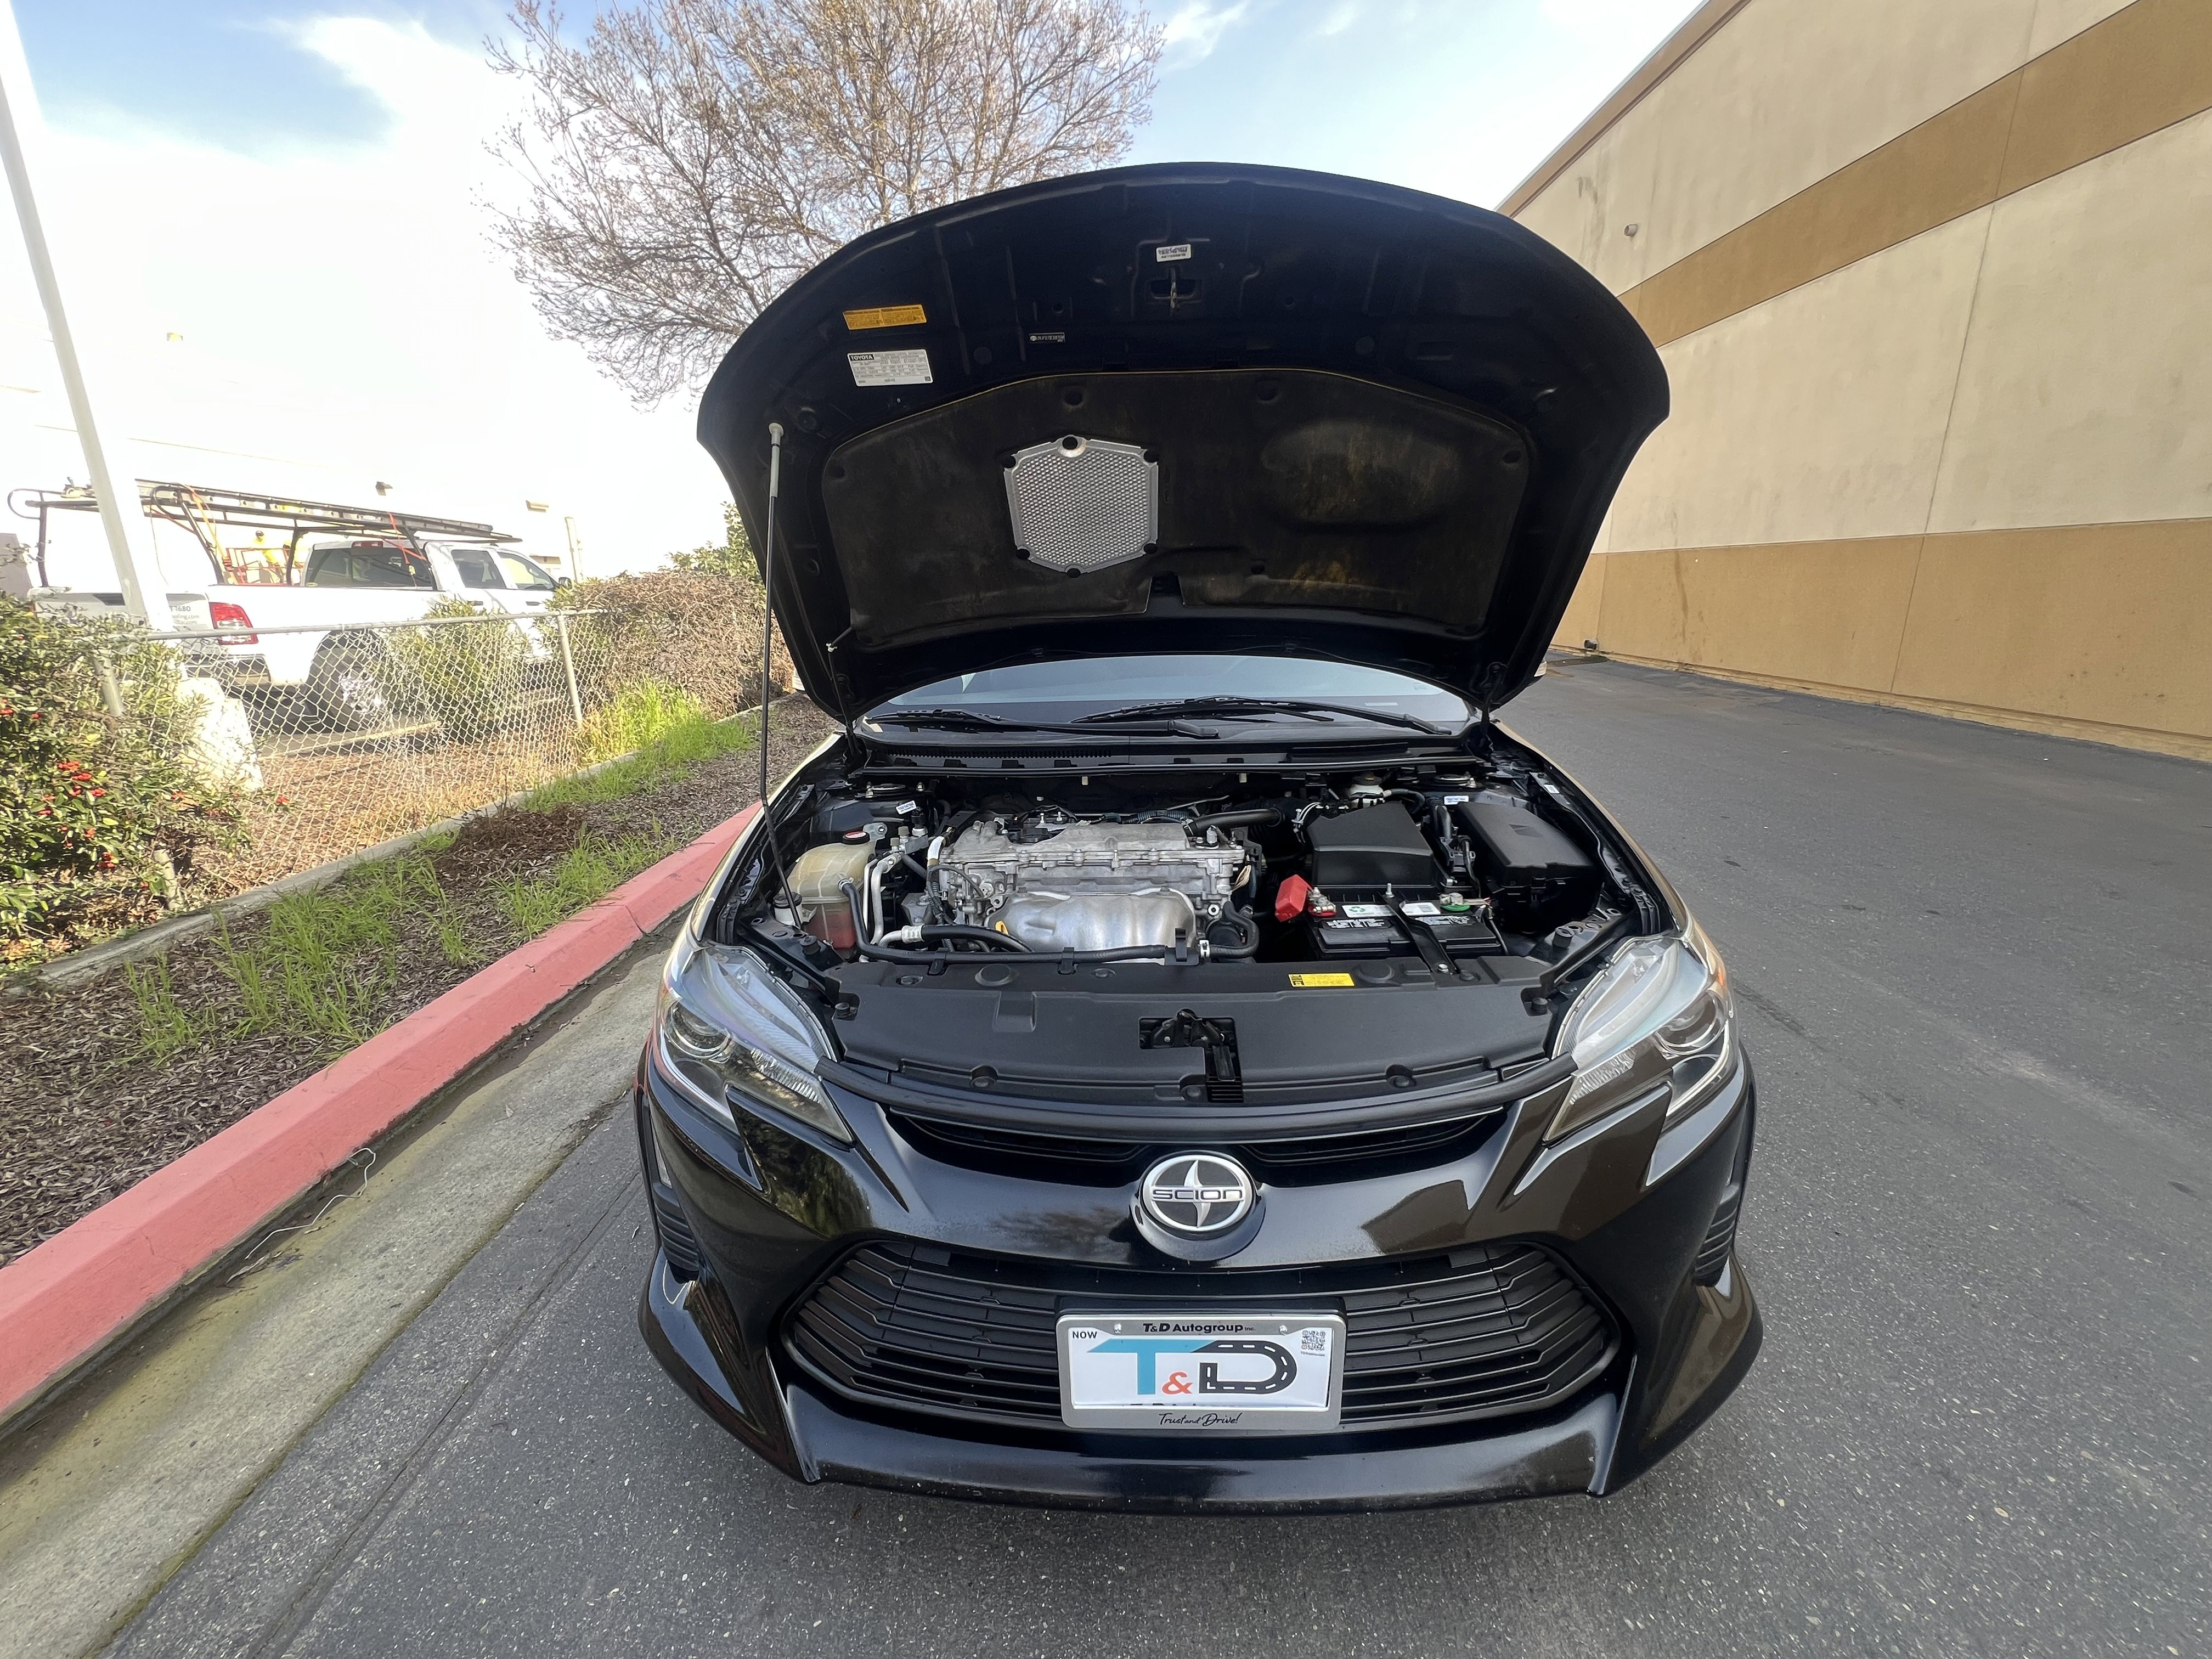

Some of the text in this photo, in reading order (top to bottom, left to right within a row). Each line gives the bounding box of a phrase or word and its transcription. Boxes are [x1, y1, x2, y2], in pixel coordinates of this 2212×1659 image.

[1152, 1189, 1243, 1200] SCION
[1172, 1323, 1244, 1334] Autogroup
[1159, 1413, 1187, 1425] Trust
[1201, 1412, 1243, 1426] Drive!
